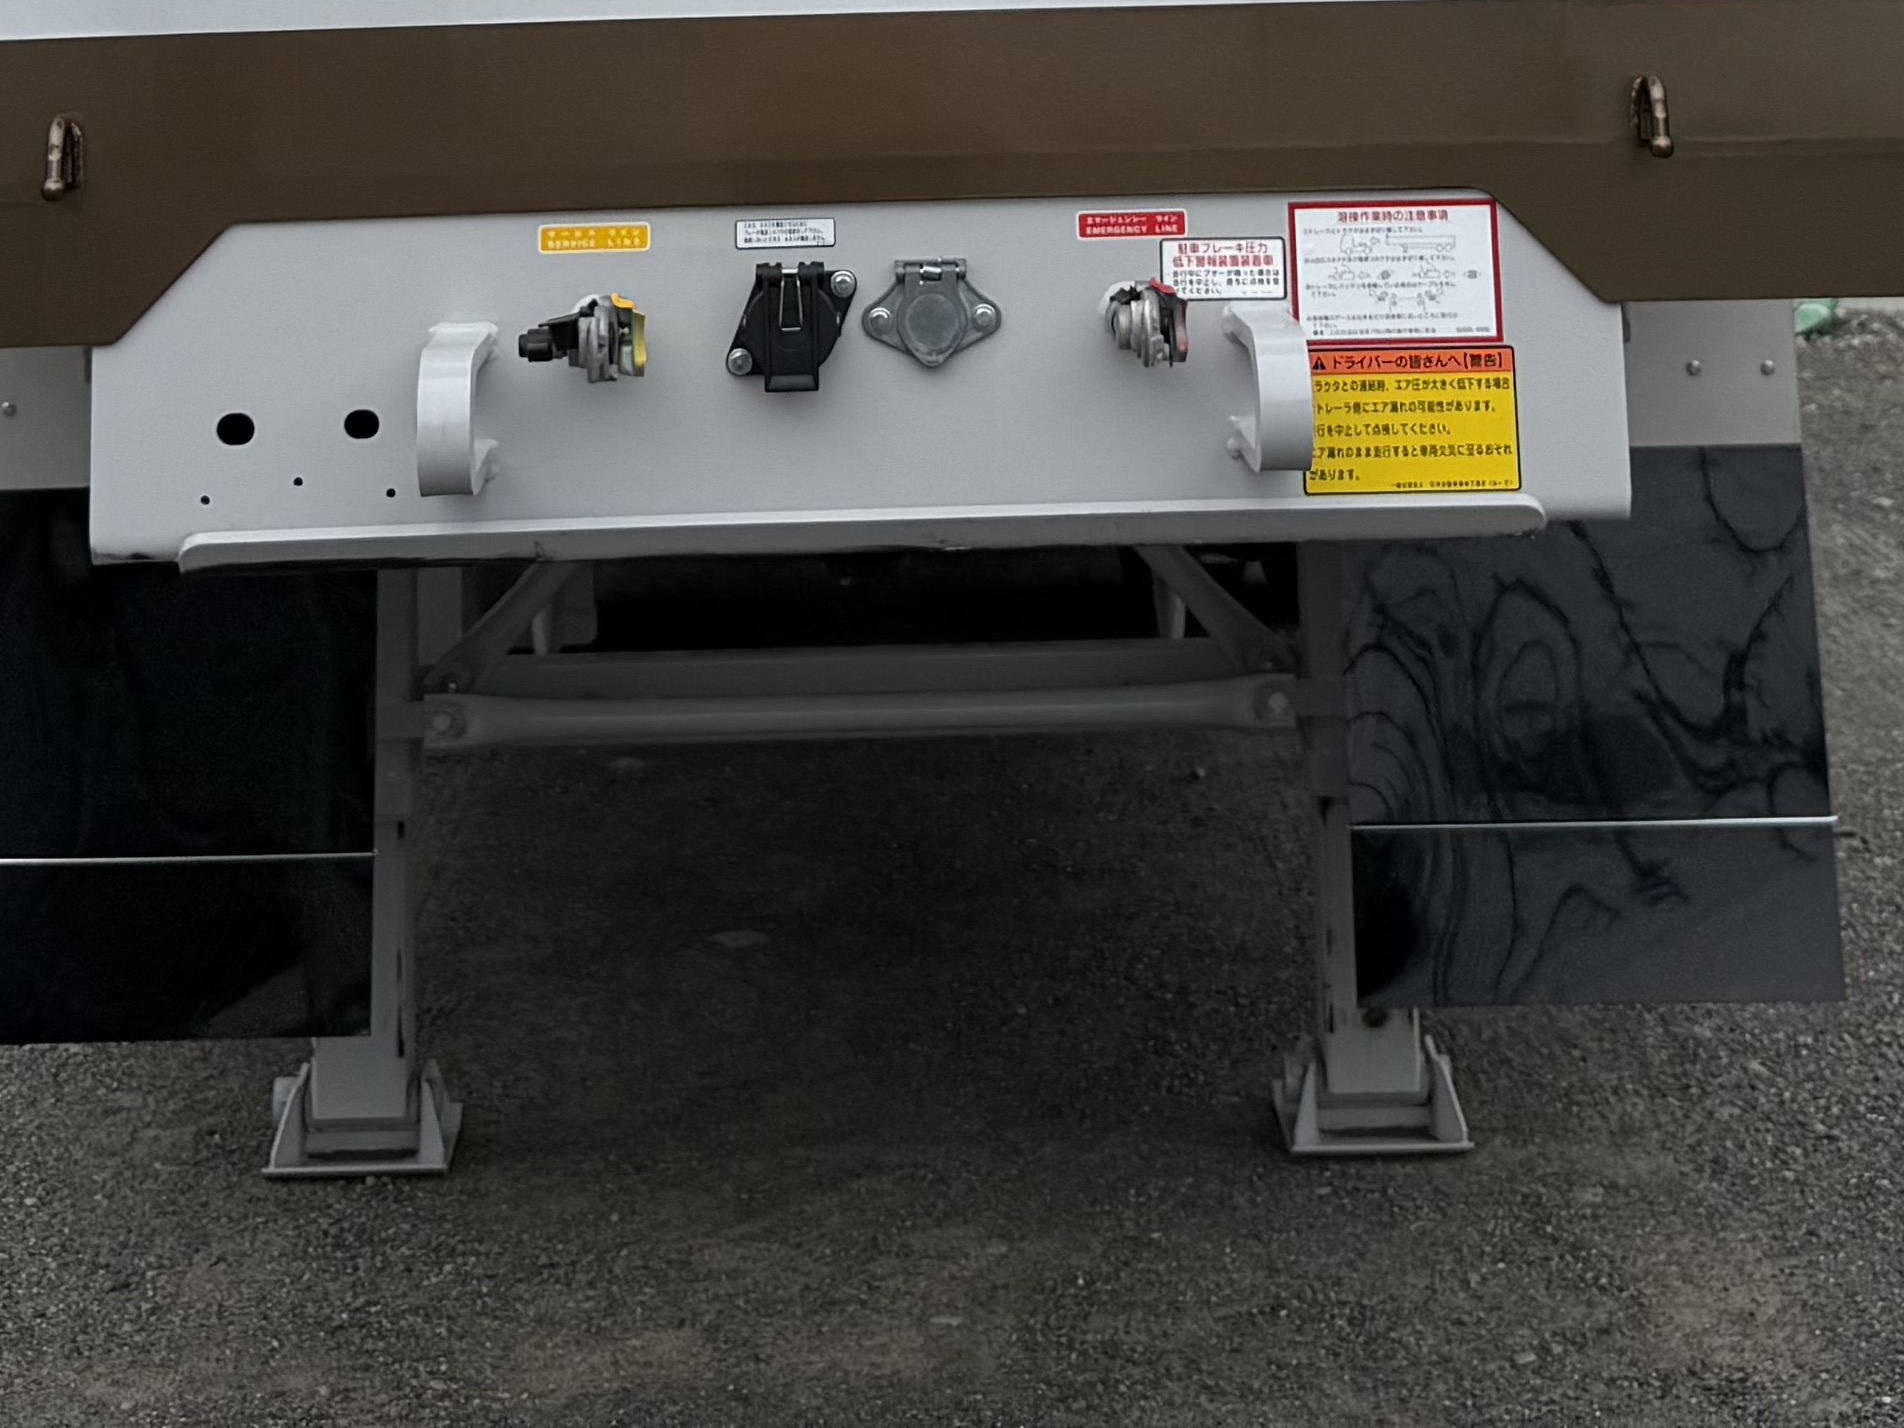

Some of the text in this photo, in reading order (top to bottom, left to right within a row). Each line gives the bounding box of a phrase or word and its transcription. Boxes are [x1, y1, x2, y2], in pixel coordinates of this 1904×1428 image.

[1155, 214, 1178, 223] ライン
[1086, 224, 1178, 235] EMERGENCY LINE
[1178, 241, 1268, 254] 駐車ブレーキ圧力
[1333, 352, 1503, 370] ドライバーの皆さんへ【警告】
[1313, 376, 1511, 393] ラクタとの連結時、エア圧が大きく低下する場合
[1314, 400, 1496, 414] トレーラ側にエア漏れの可能性があります。
[1314, 422, 1451, 437] 行を中止して点検してください。
